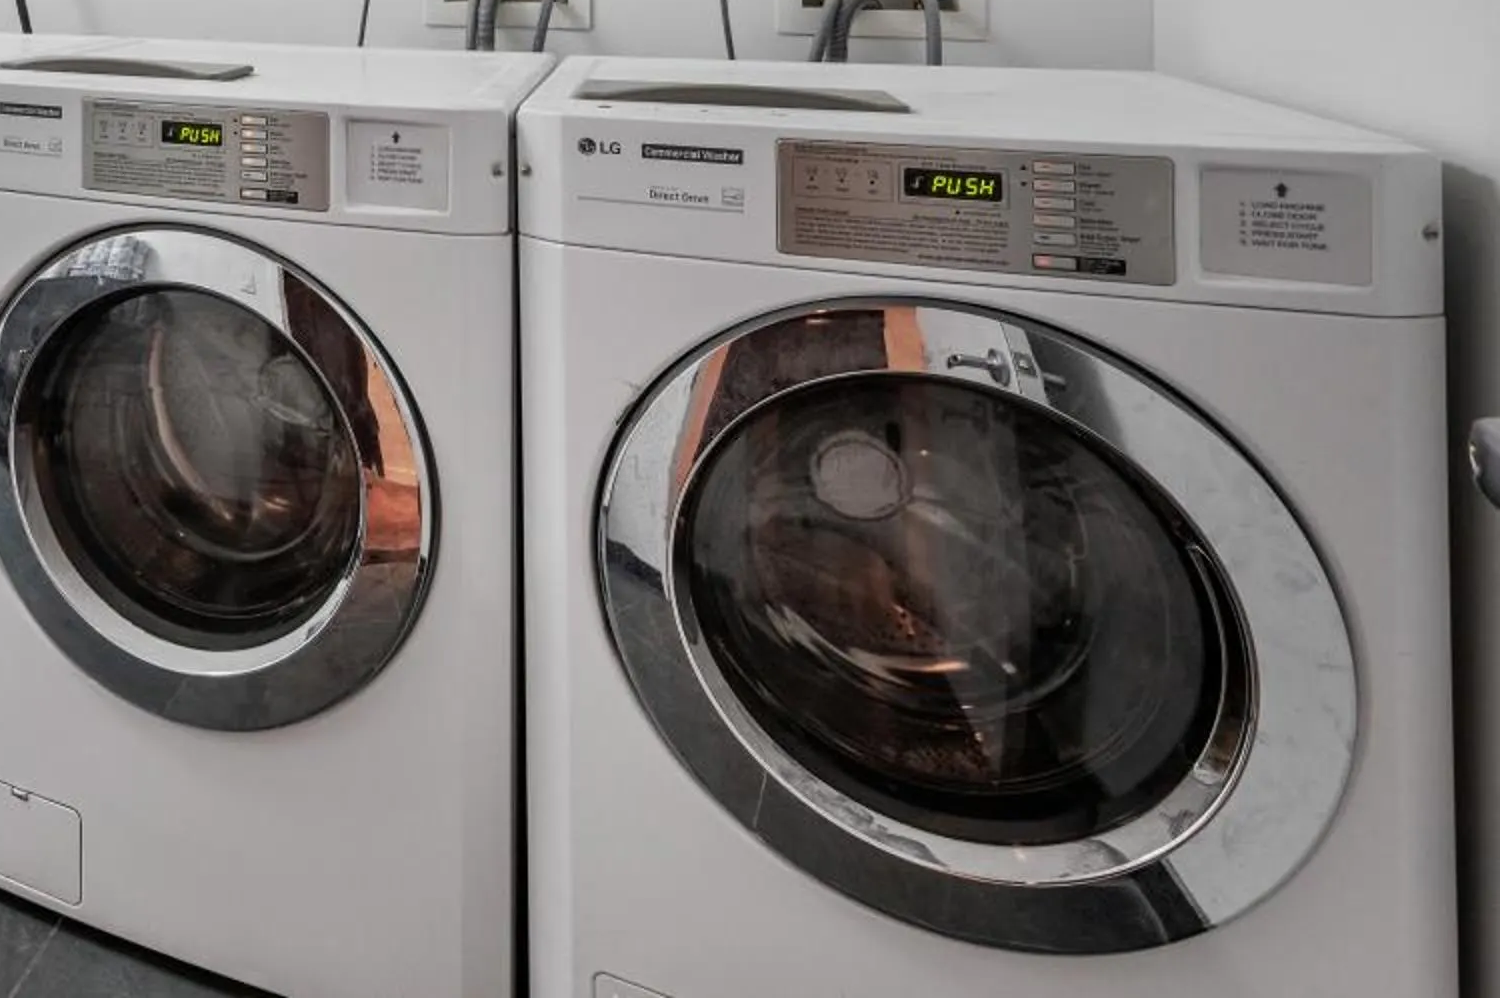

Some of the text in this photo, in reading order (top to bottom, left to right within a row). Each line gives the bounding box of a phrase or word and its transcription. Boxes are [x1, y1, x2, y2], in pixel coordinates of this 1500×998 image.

[180, 127, 220, 143] PUSH
[600, 141, 621, 155] LG
[931, 174, 995, 195] PUSH
[650, 189, 679, 199] Direct
